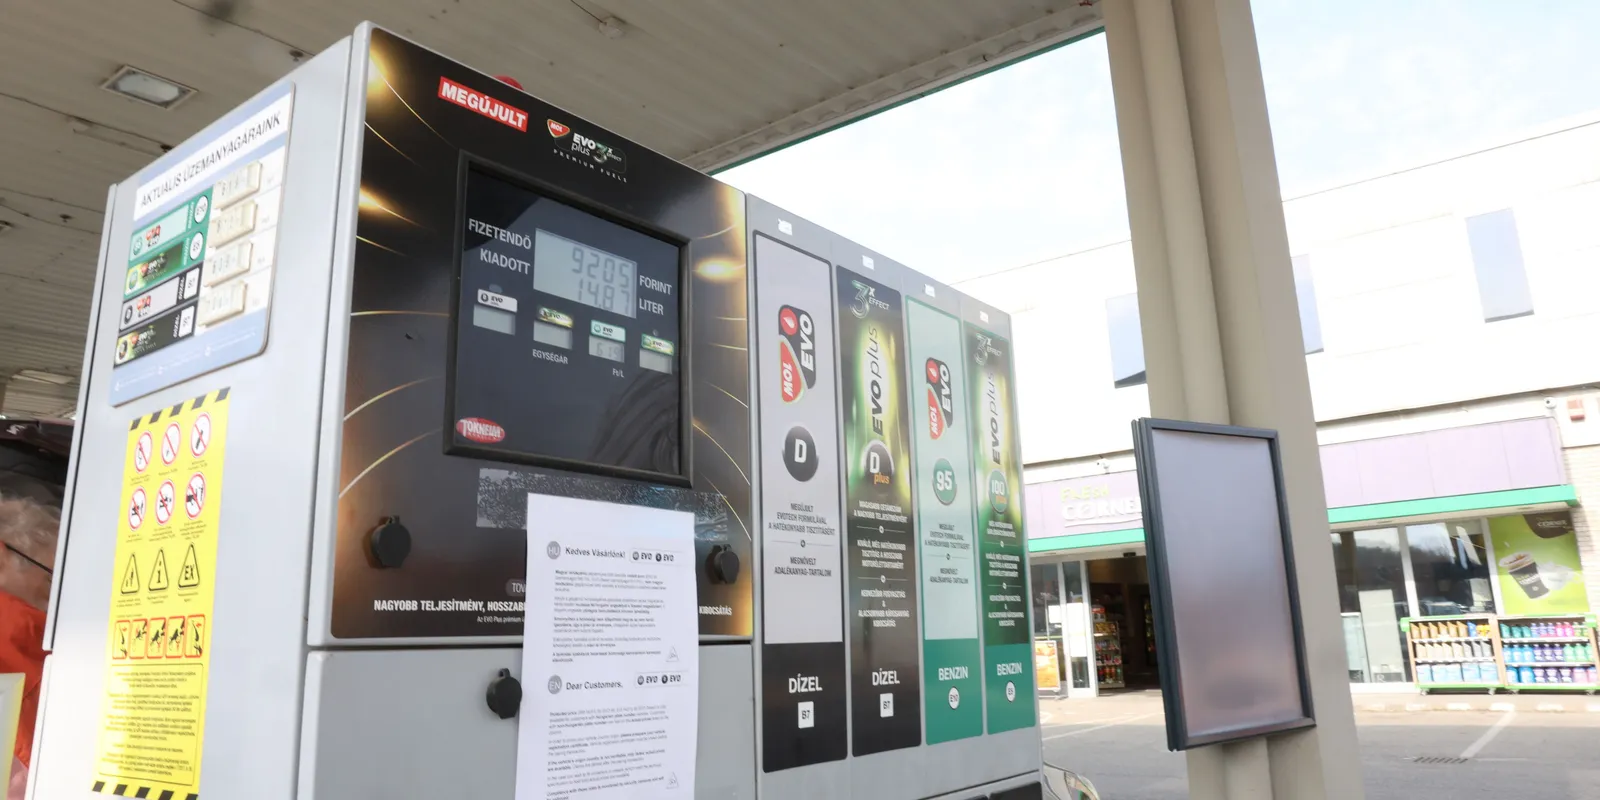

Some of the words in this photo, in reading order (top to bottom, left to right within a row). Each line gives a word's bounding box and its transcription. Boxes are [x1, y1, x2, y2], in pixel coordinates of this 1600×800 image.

[442, 82, 526, 128] MEGÚJULT
[571, 142, 591, 156] plus
[572, 132, 597, 150] EVO
[468, 218, 532, 250] FIZETENDŐ
[571, 246, 630, 289] 9205
[639, 275, 673, 295] FORINT
[480, 248, 531, 275] KIADOTT
[639, 298, 664, 316] LITER
[869, 297, 890, 310] EFFECT
[800, 314, 813, 372] EVO
[783, 362, 792, 397] MOL
[940, 364, 951, 413] EVO
[869, 383, 883, 436] EVO
[794, 439, 807, 463] D
[989, 417, 1001, 465] EVO
[869, 452, 880, 473] D
[936, 471, 953, 491] 95
[565, 547, 590, 557] Kedves
[374, 599, 417, 611] NAGYOBB
[487, 600, 525, 612] HOSSZAB
[646, 675, 658, 684] EVO
[670, 674, 681, 683] EVO
[872, 667, 900, 686] DÍZEL
[938, 666, 969, 682] BENZIN
[996, 662, 1022, 676] BENZIN
[566, 682, 583, 690] Dear
[584, 681, 623, 690] Customers,
[788, 673, 823, 694] DÍZEL
[801, 710, 811, 720] B7
